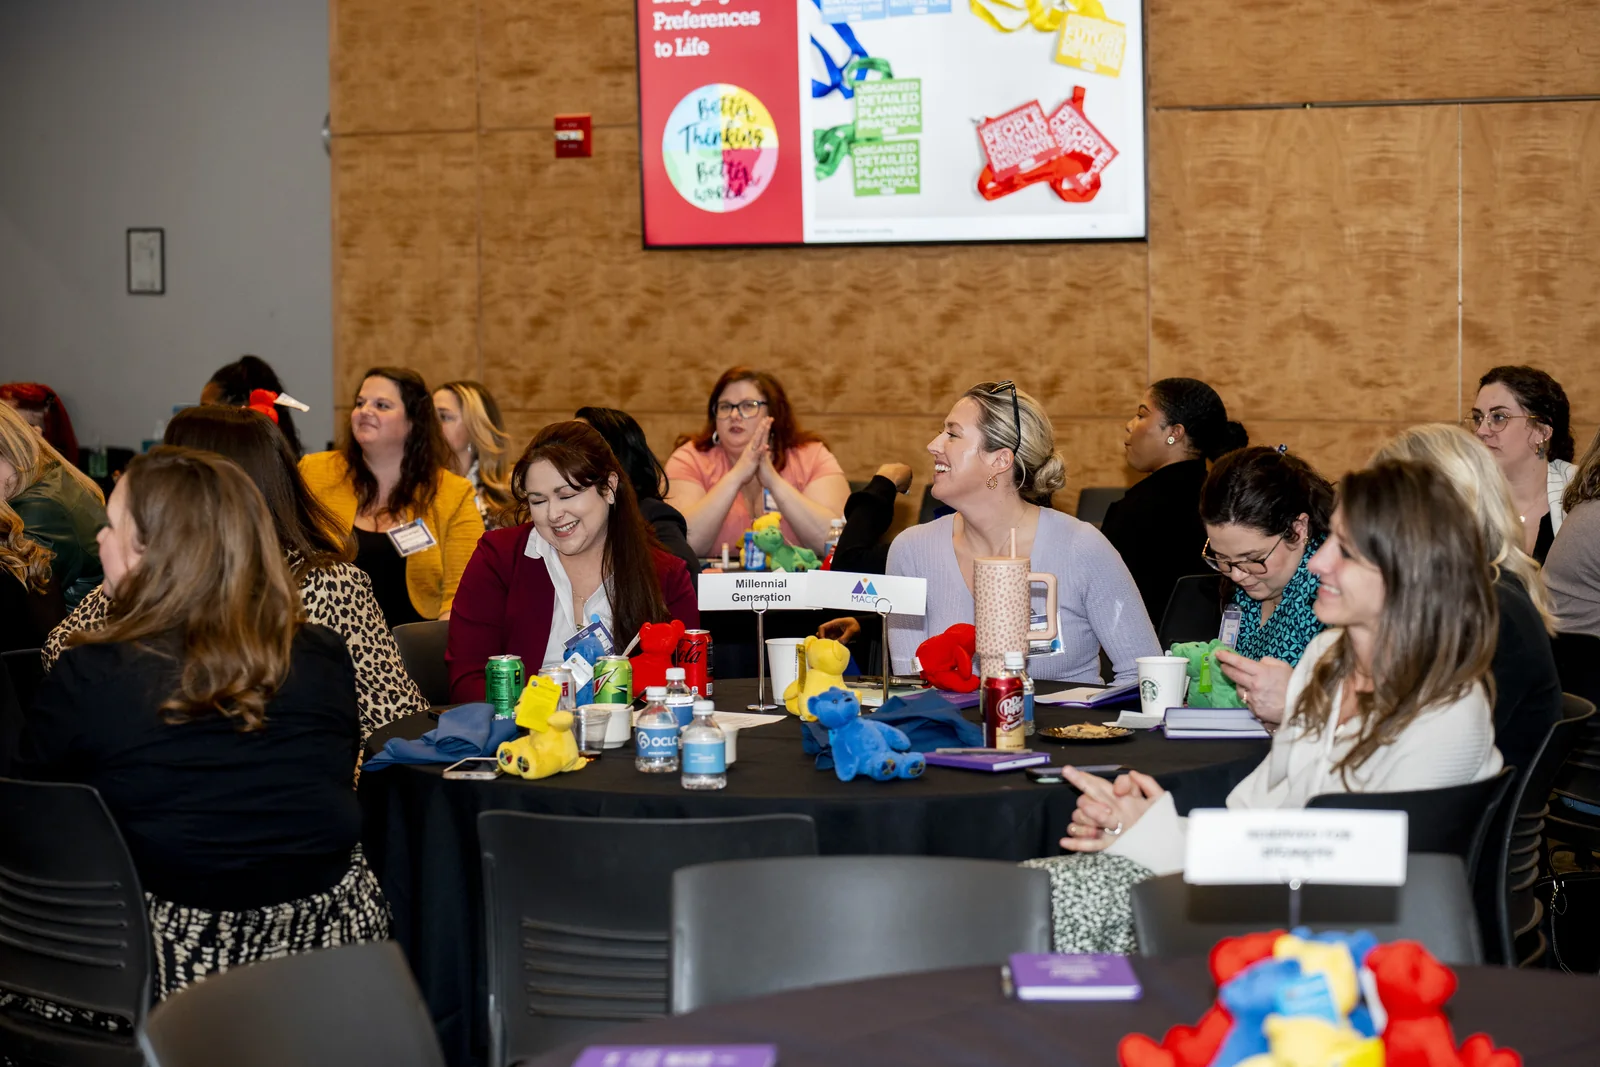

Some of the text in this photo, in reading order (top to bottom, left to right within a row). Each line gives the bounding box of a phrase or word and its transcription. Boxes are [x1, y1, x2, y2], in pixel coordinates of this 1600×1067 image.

[653, 10, 760, 31] Preferences
[654, 36, 710, 58] to Life
[857, 91, 919, 106] DETAILED
[858, 103, 920, 118] PLANNED
[982, 109, 1043, 146] PEOPLE
[1054, 109, 1111, 167] PEOPLE
[853, 142, 917, 156] ORGANIZED
[855, 153, 917, 167] DETAILED
[856, 165, 918, 179] PLANNED
[735, 579, 787, 589] Millennial
[731, 592, 791, 602] Generation
